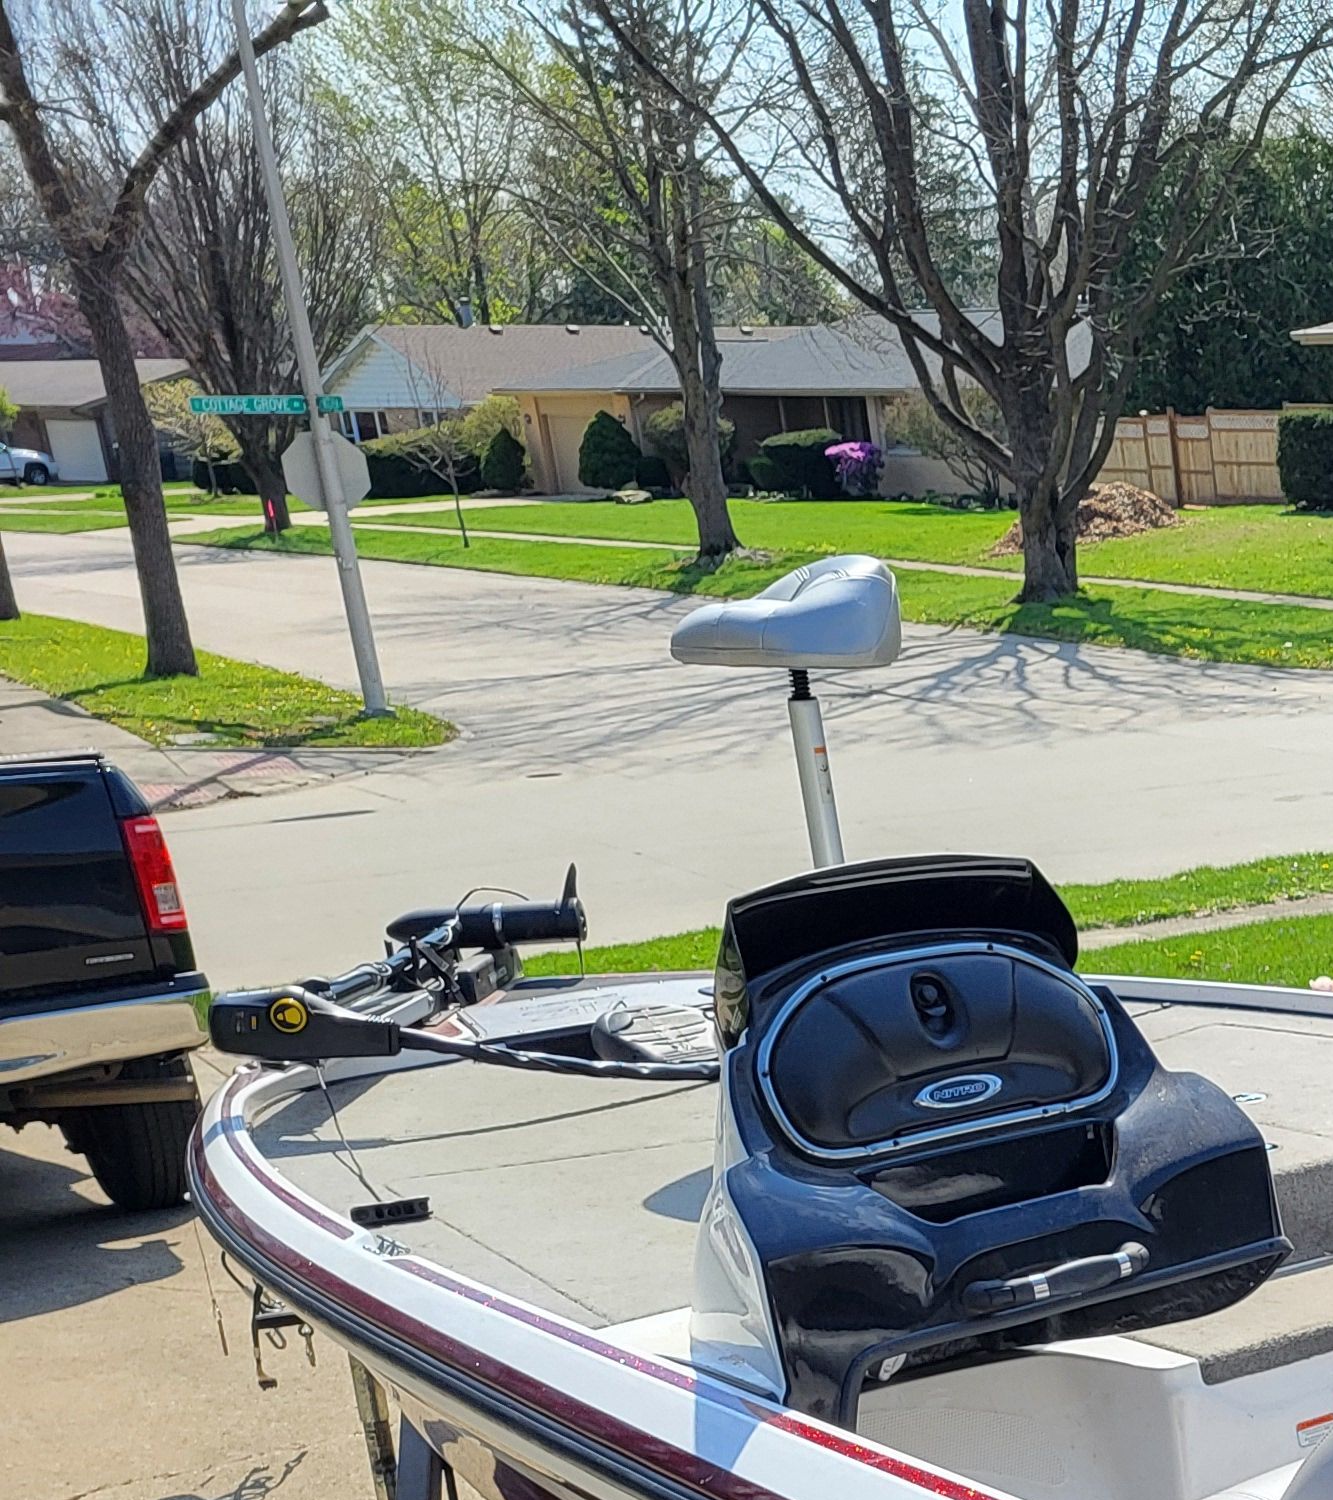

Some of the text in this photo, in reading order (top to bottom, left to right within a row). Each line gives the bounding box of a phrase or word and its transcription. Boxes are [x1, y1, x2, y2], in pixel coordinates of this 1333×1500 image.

[202, 398, 248, 411] COTTAGE
[253, 398, 289, 411] GROVE
[933, 1082, 986, 1100] NITRO
